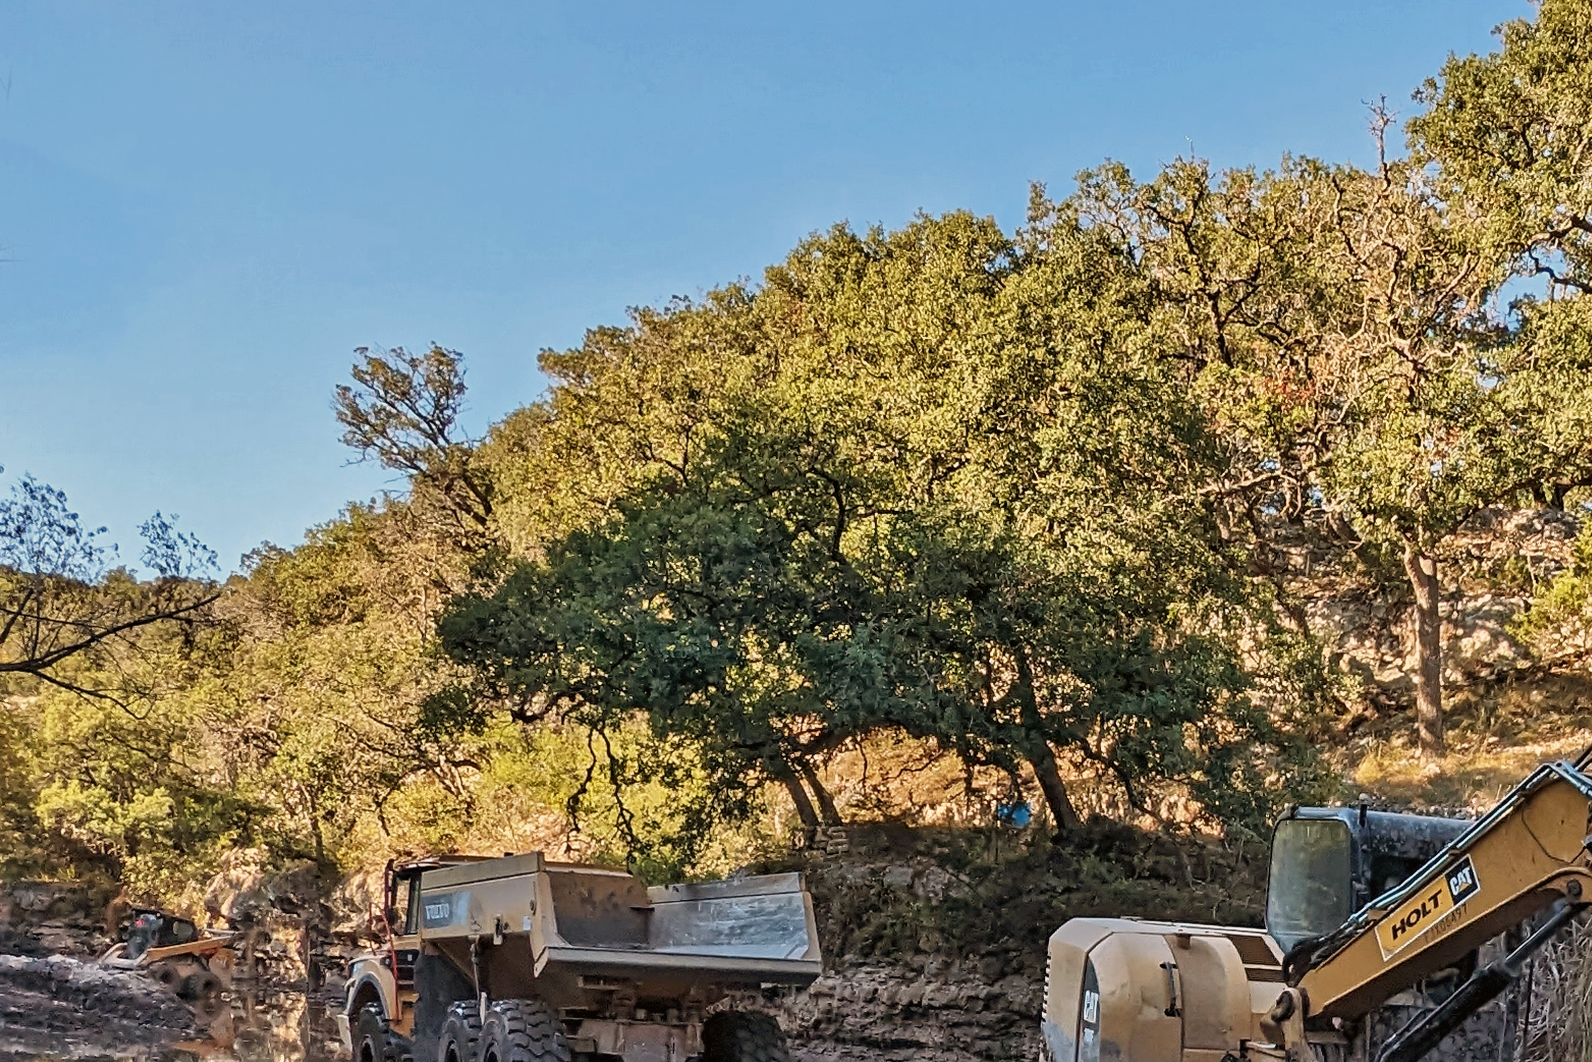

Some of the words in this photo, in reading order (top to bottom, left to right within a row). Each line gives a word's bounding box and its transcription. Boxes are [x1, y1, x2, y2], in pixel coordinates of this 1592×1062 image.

[1392, 889, 1442, 940] HOLT
[1449, 866, 1472, 896] CAT
[1083, 990, 1099, 1023] CAT
